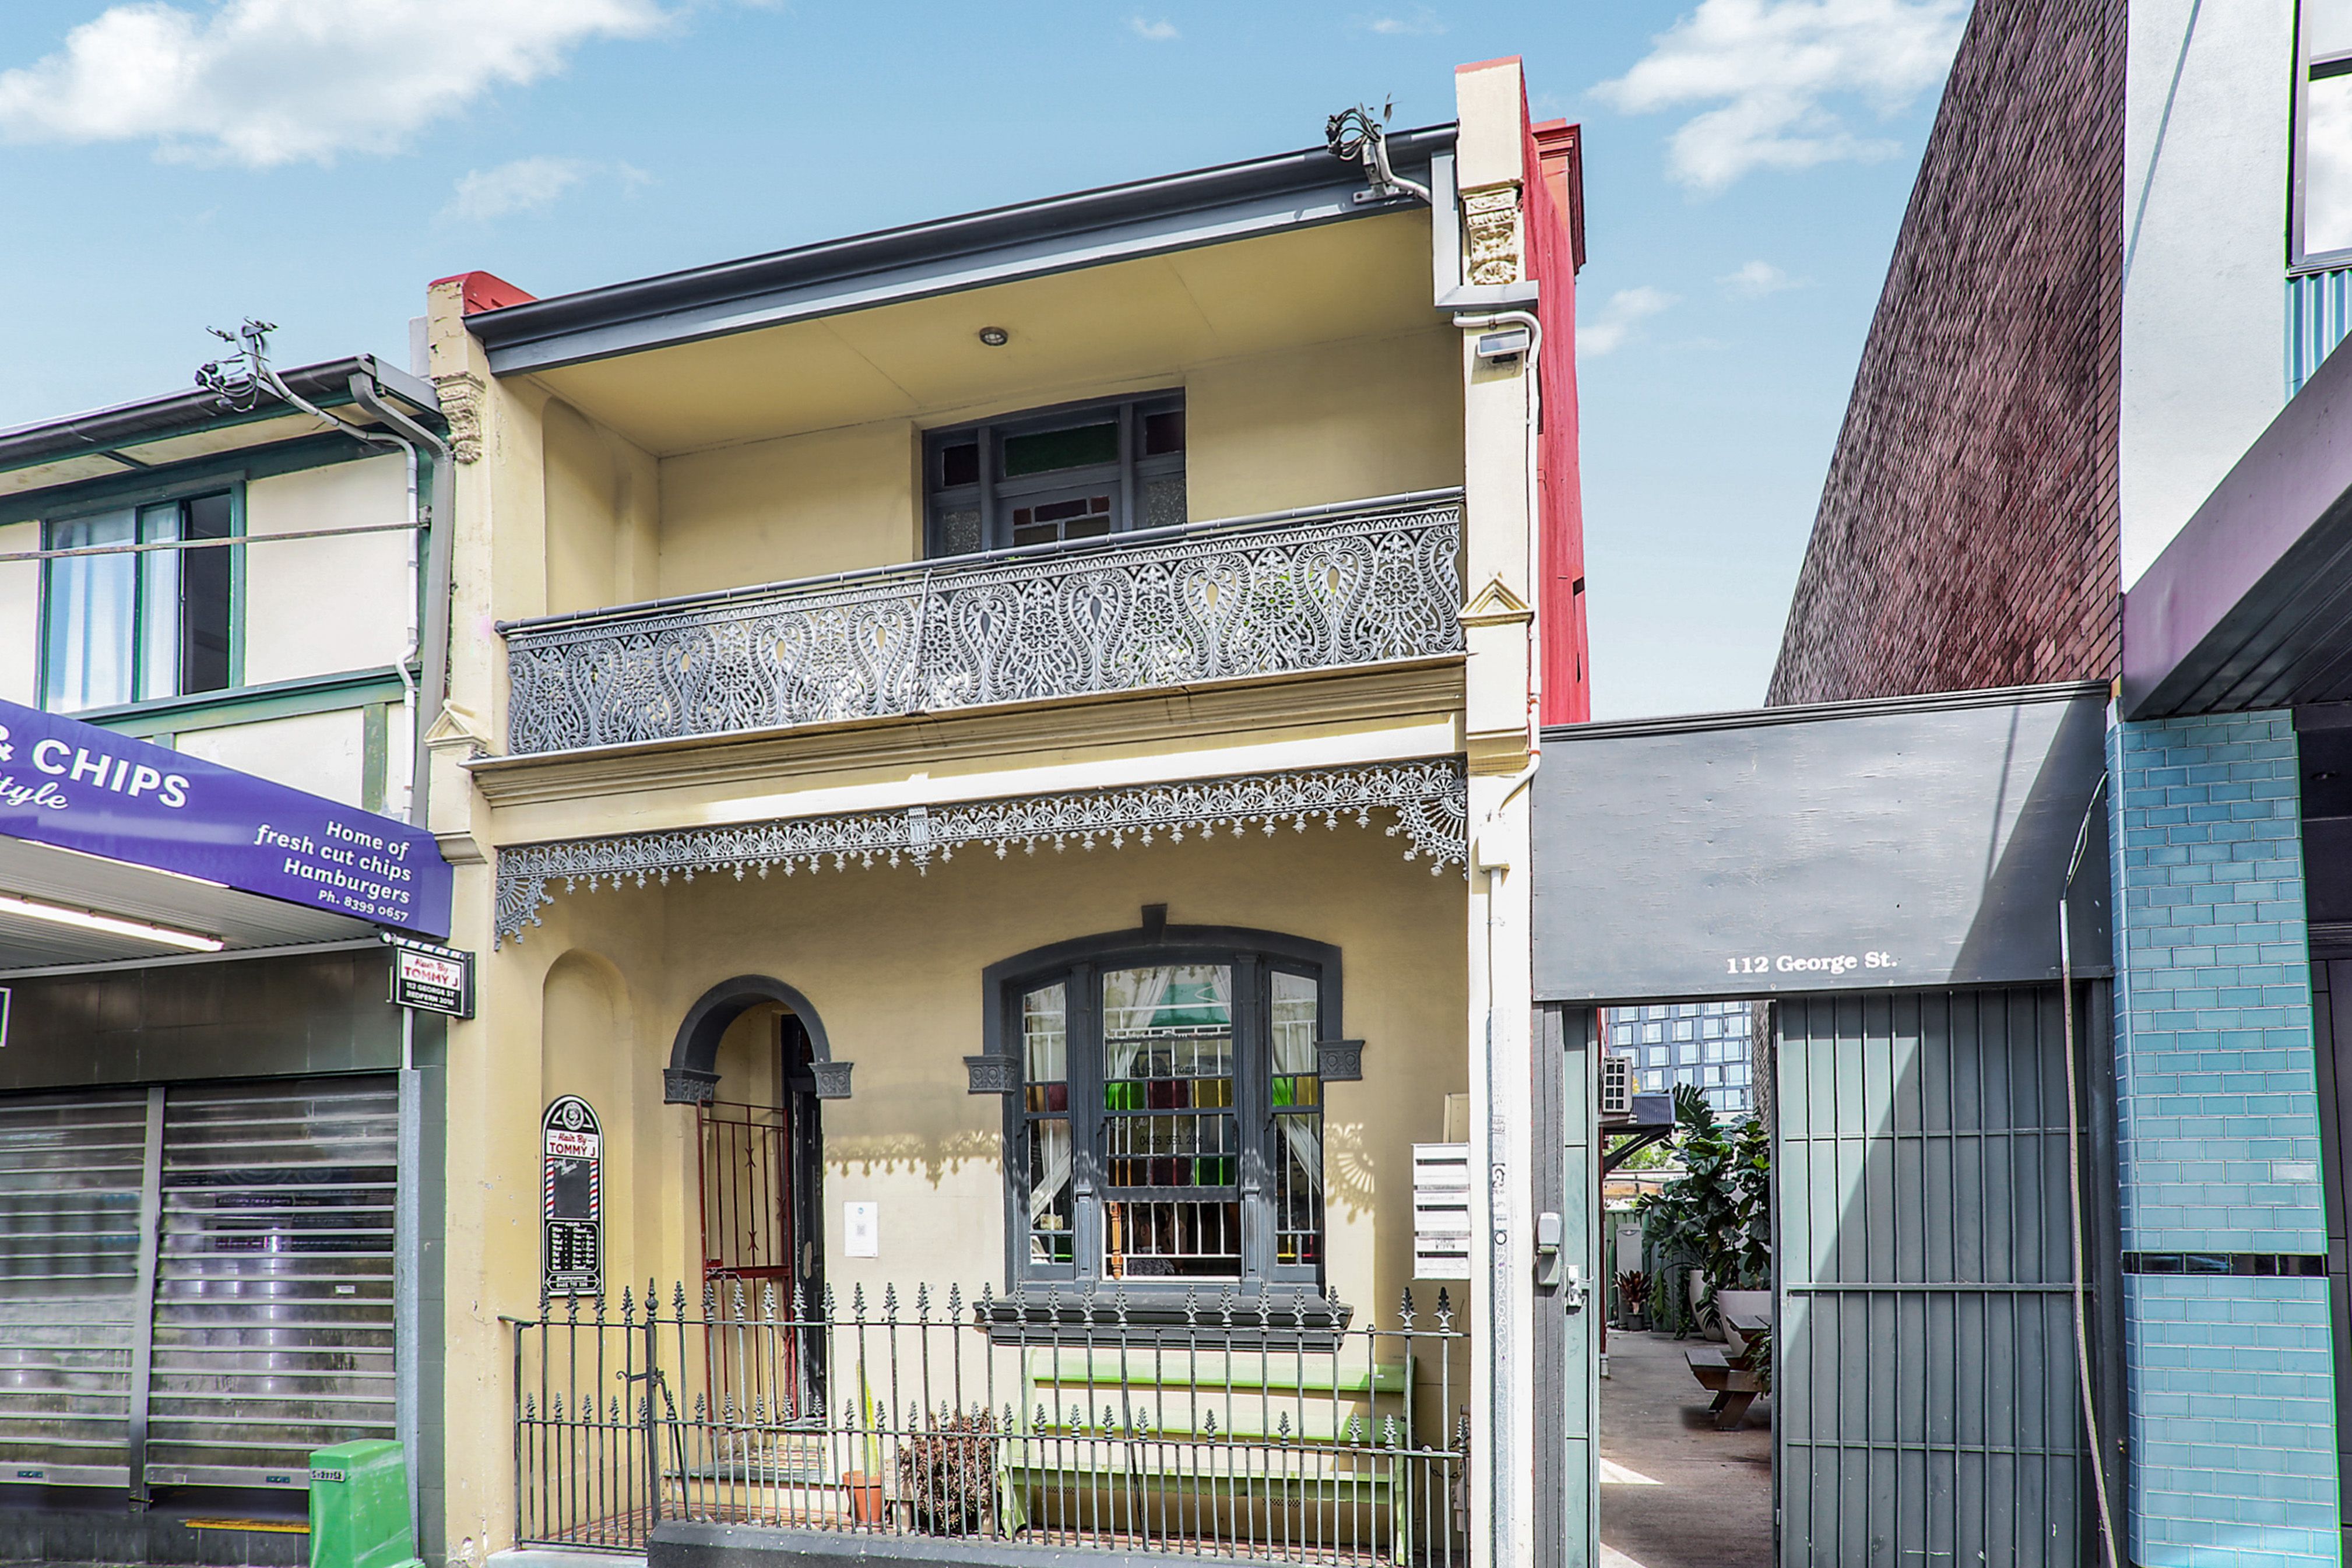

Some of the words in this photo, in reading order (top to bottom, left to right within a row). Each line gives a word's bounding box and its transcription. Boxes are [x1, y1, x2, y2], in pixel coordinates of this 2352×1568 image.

[32, 739, 191, 808] CHIPS
[0, 772, 69, 810] tyle
[254, 824, 314, 856] fresh
[320, 845, 354, 866] cut
[359, 855, 412, 882] chips
[326, 820, 384, 850] Home
[388, 842, 410, 861] of
[283, 857, 410, 904] Hamburgers
[318, 890, 340, 905] Ph.
[344, 896, 375, 914] 8399
[378, 905, 409, 922] 0657
[404, 966, 449, 985] TOMMY
[452, 978, 458, 987] J
[1727, 957, 1769, 973] 112
[1776, 955, 1858, 975] George
[1865, 951, 1897, 968] St.
[406, 990, 438, 1002] REDFERN
[417, 984, 445, 996] GEORGE
[447, 989, 455, 998] ST
[550, 1142, 587, 1156] TOMMY
[590, 1147, 596, 1156] J
[558, 1133, 575, 1142] Hair
[576, 1134, 587, 1145] By
